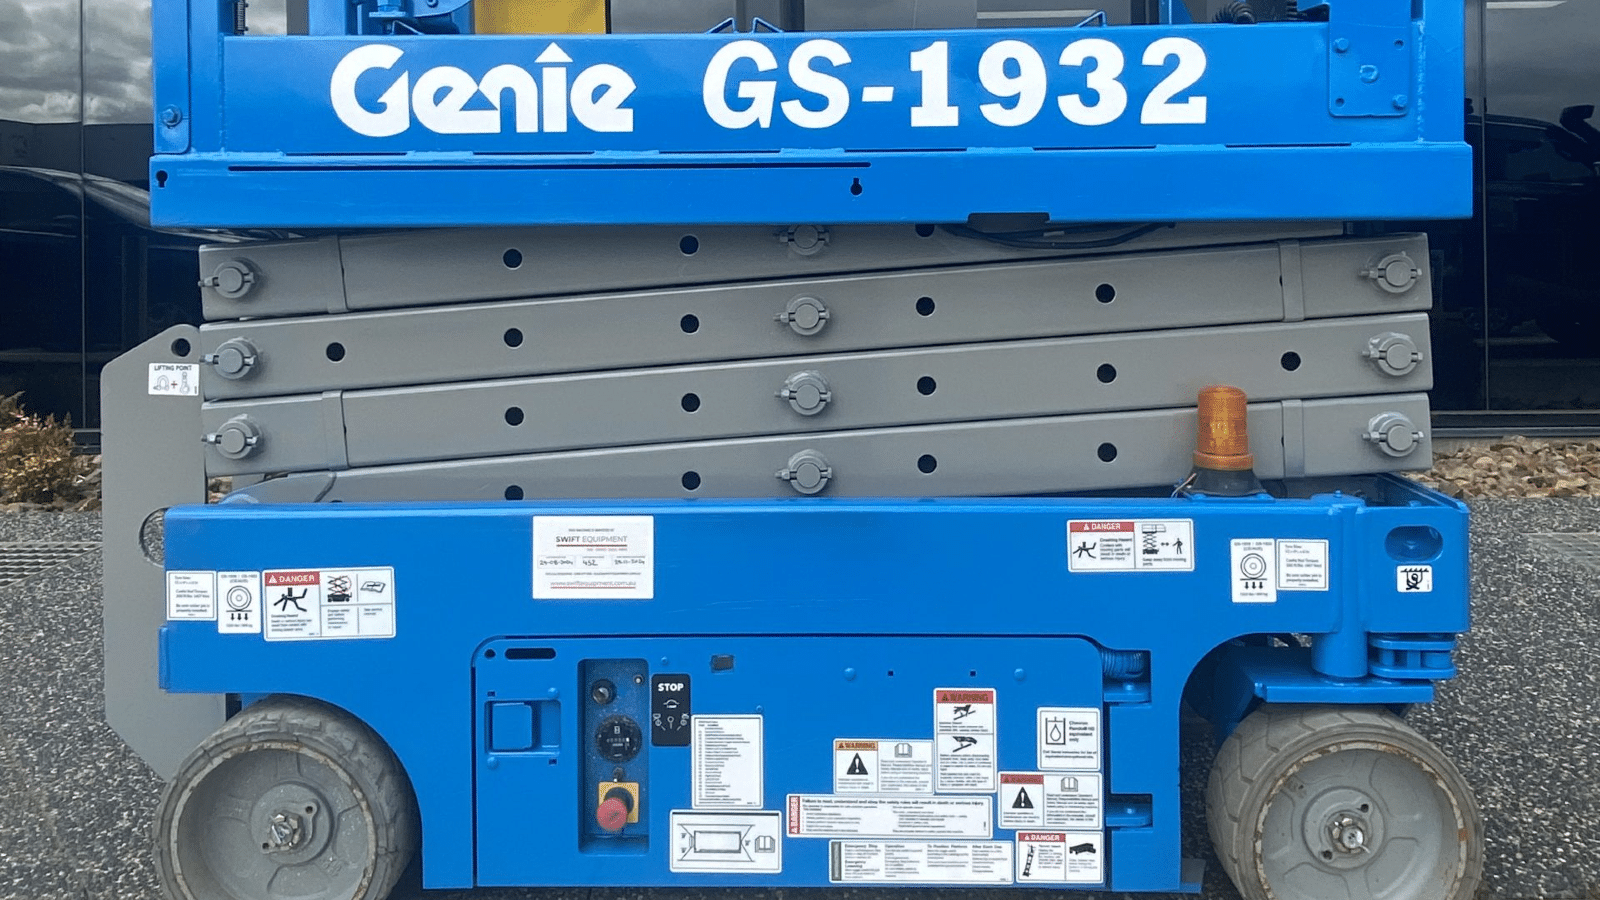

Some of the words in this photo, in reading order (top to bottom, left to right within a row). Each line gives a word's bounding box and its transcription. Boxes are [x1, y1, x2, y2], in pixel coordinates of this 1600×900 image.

[329, 42, 636, 137] Genie
[703, 38, 1208, 130] GS-1932
[555, 535, 580, 543] SWIFT
[582, 535, 628, 543] EQUIPMENT
[279, 574, 315, 583] DANGER
[658, 682, 684, 692] STOP
[950, 693, 988, 702] WARNING
[790, 796, 798, 827] DANGER
